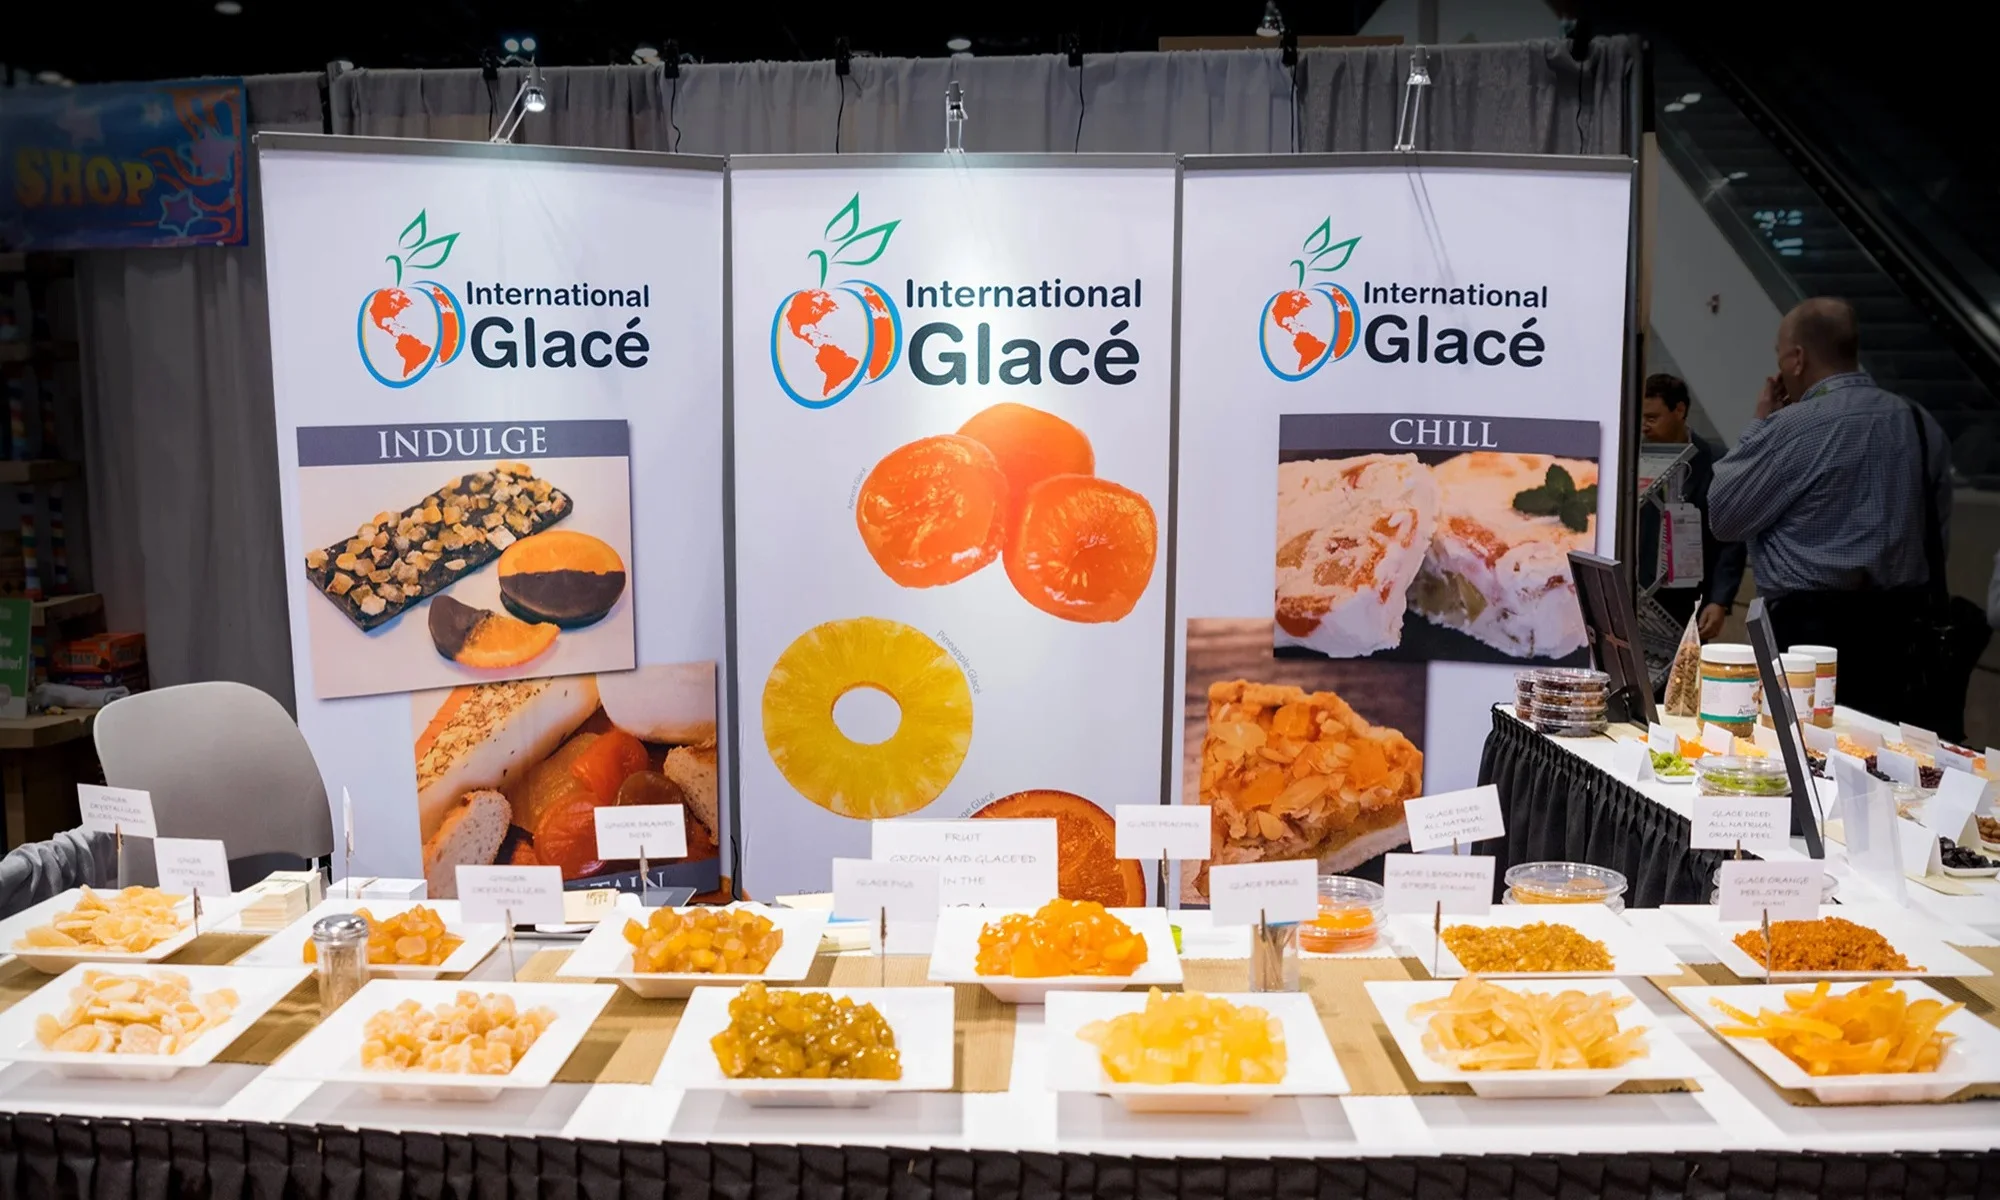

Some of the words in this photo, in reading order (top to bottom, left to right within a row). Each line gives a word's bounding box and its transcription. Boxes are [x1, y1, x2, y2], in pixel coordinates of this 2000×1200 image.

[16, 147, 153, 207] SHOP
[466, 281, 650, 308] International
[906, 278, 1142, 308] International
[1363, 281, 1548, 308] International
[470, 315, 651, 368] Glacé
[908, 319, 1140, 386] Glacé
[1363, 314, 1546, 368] Glacé
[378, 426, 548, 459] INDULGE
[1389, 418, 1498, 449] CHILL
[936, 629, 970, 669] Pineapple
[967, 668, 983, 696] Glacé
[1712, 810, 1743, 818] GLACE
[1745, 810, 1771, 818] DICED
[945, 832, 981, 843] FRUIT
[1429, 830, 1460, 840] LEMON
[1462, 825, 1484, 835] PEEL
[889, 854, 941, 864] GROWN
[944, 854, 971, 864] AND
[943, 875, 957, 886] IN
[959, 875, 986, 885] THE
[1426, 869, 1462, 878] LEMON
[1464, 871, 1489, 881] PEEL
[1734, 876, 1766, 886] GLACE
[1767, 876, 1810, 886] ORANGE
[1765, 889, 1800, 897] STRIPS
